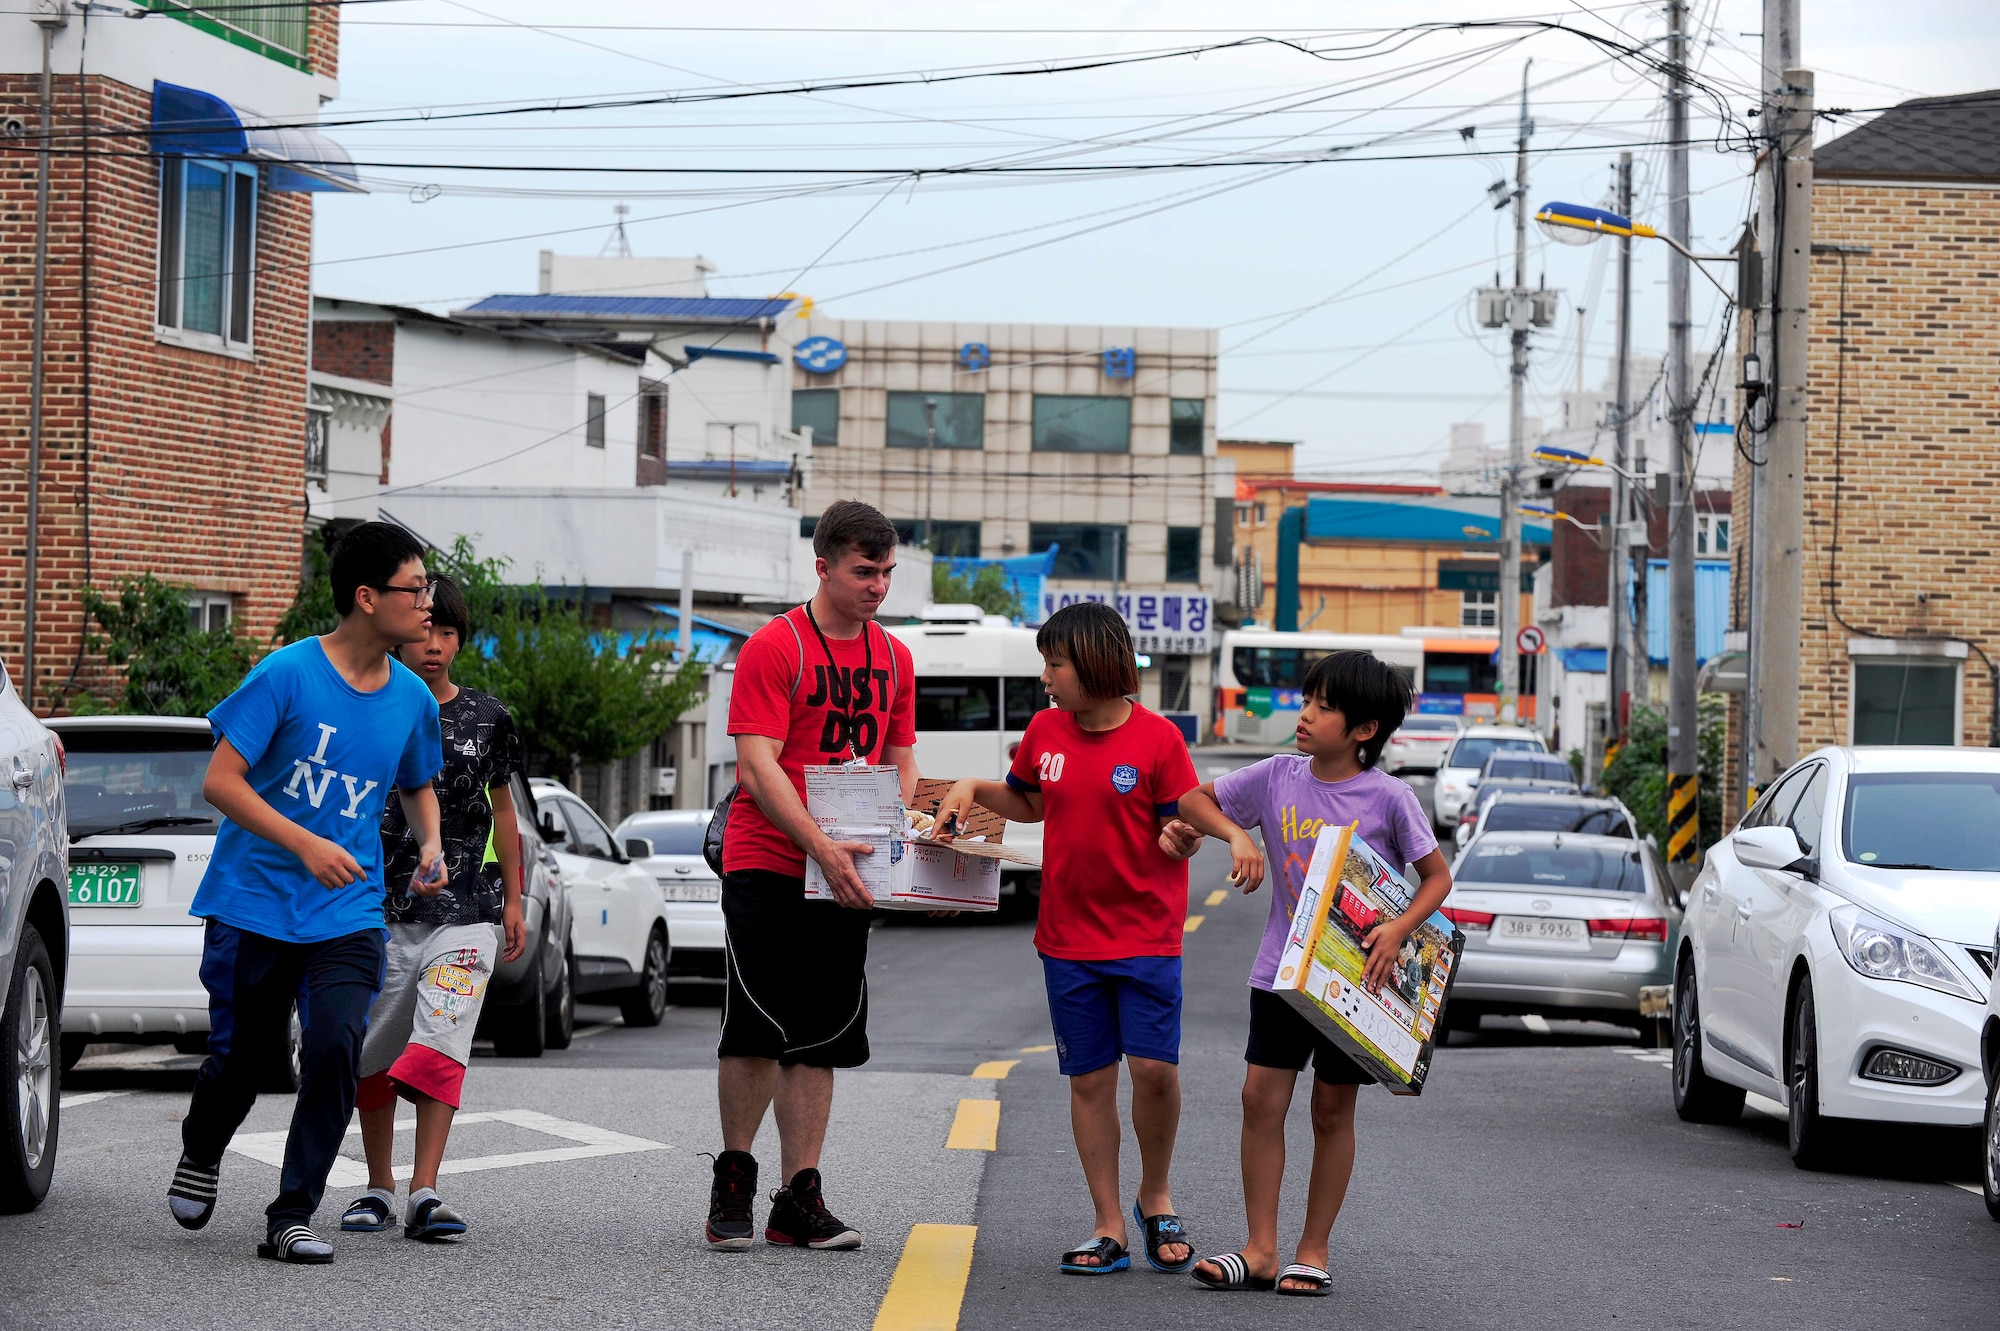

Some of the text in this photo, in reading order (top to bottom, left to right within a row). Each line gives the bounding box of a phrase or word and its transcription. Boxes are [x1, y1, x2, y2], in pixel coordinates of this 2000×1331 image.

[806, 665, 889, 712] JUST
[307, 722, 337, 766] I
[819, 710, 878, 757] DO
[1040, 752, 1065, 782] 20
[283, 759, 378, 819] NY
[914, 847, 944, 858] PRIORITY
[1540, 922, 1572, 936] 5936
[457, 949, 478, 965] 45
[440, 975, 470, 992] TEAMS
[445, 967, 469, 981] BEST
